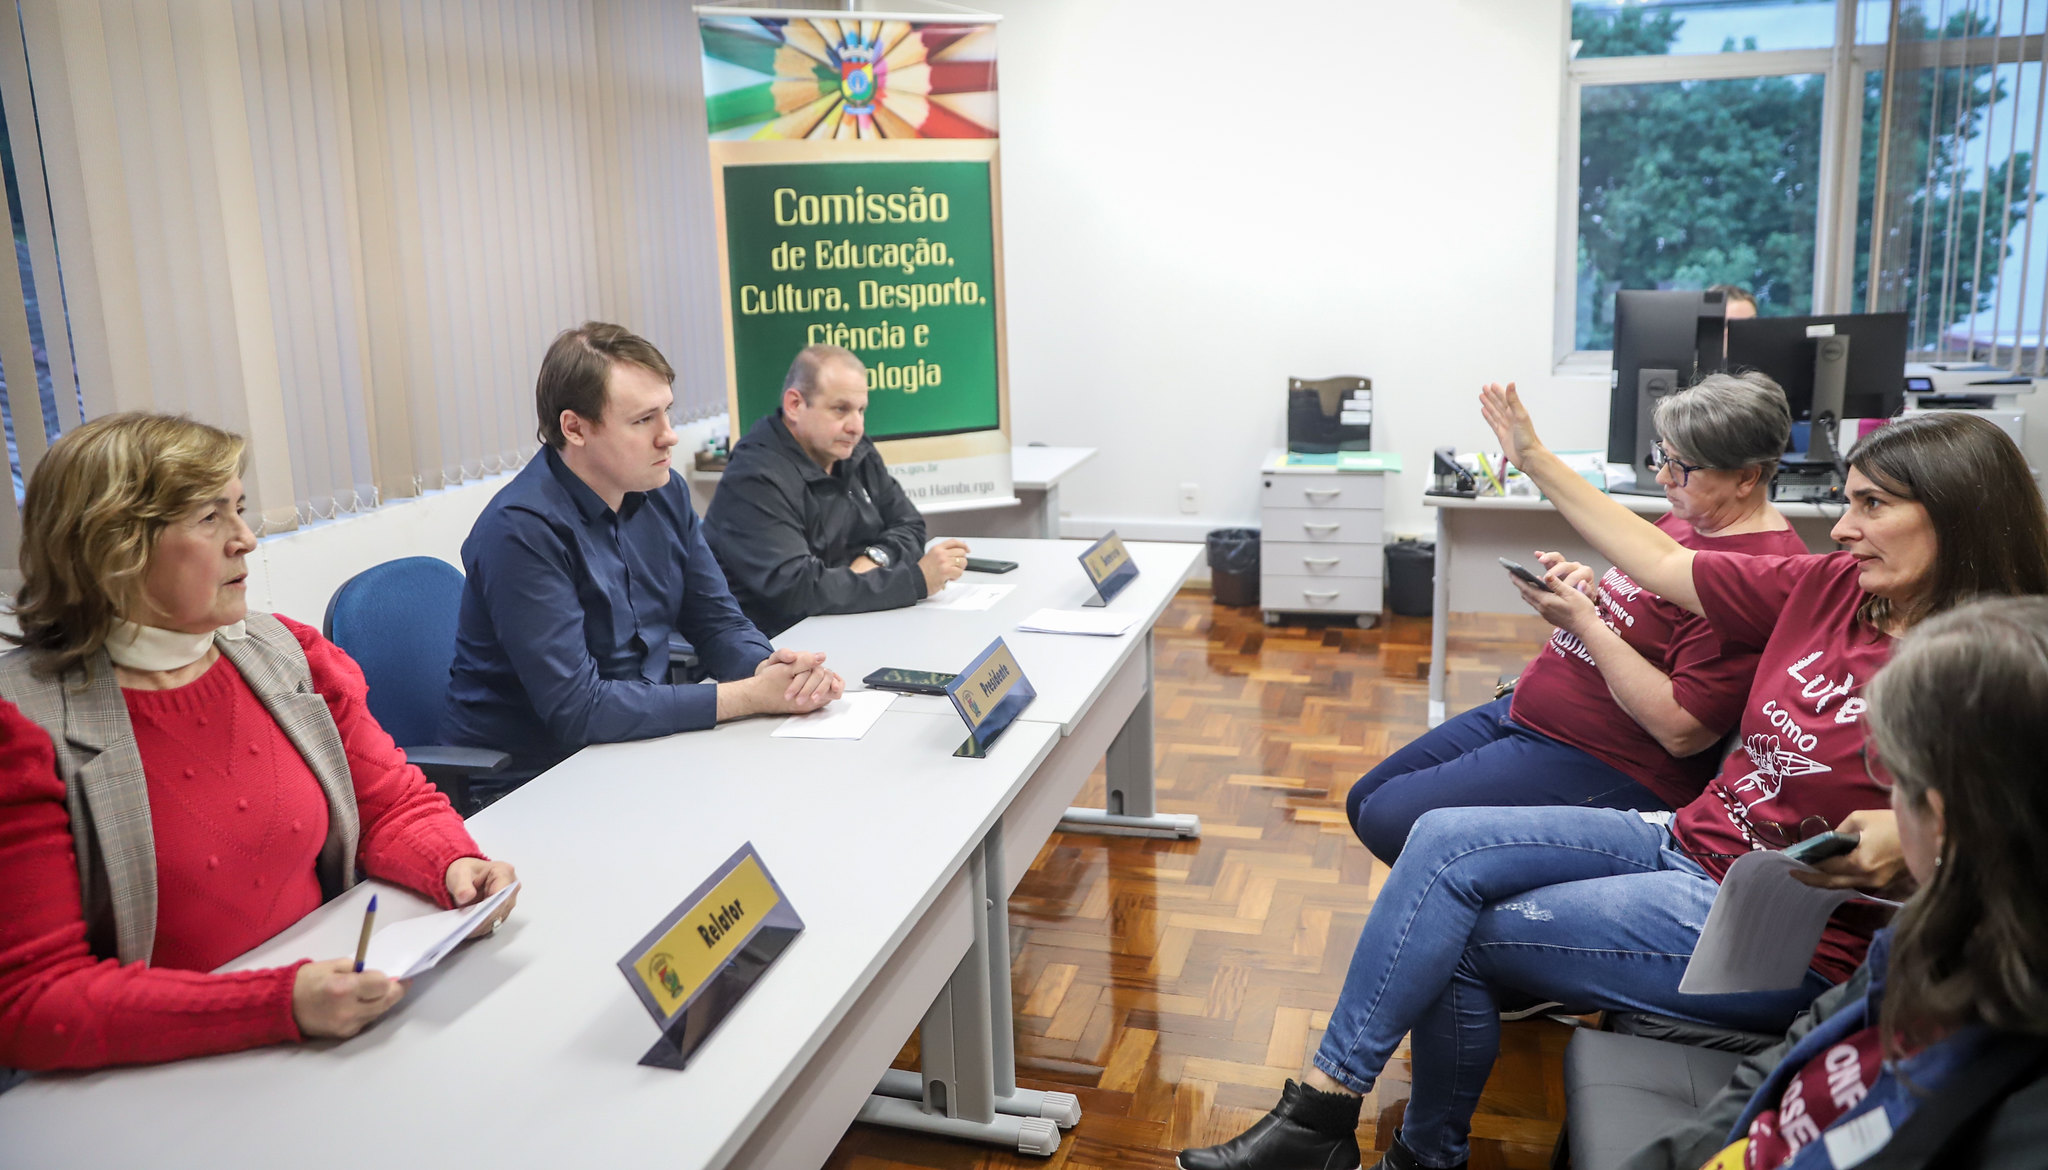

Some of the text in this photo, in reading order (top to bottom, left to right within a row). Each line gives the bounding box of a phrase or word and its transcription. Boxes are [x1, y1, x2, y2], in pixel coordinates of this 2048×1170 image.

[774, 186, 949, 226] Comissão
[771, 241, 806, 272] de
[740, 276, 986, 315] Cultura, Desporto,
[807, 320, 929, 351] Ciência e
[865, 359, 942, 394] ologia
[930, 480, 995, 497] Hamburgo
[979, 663, 1010, 697] Presidente
[1787, 650, 1868, 723] Lute
[1762, 700, 1818, 752] como
[697, 898, 745, 949] Relator
